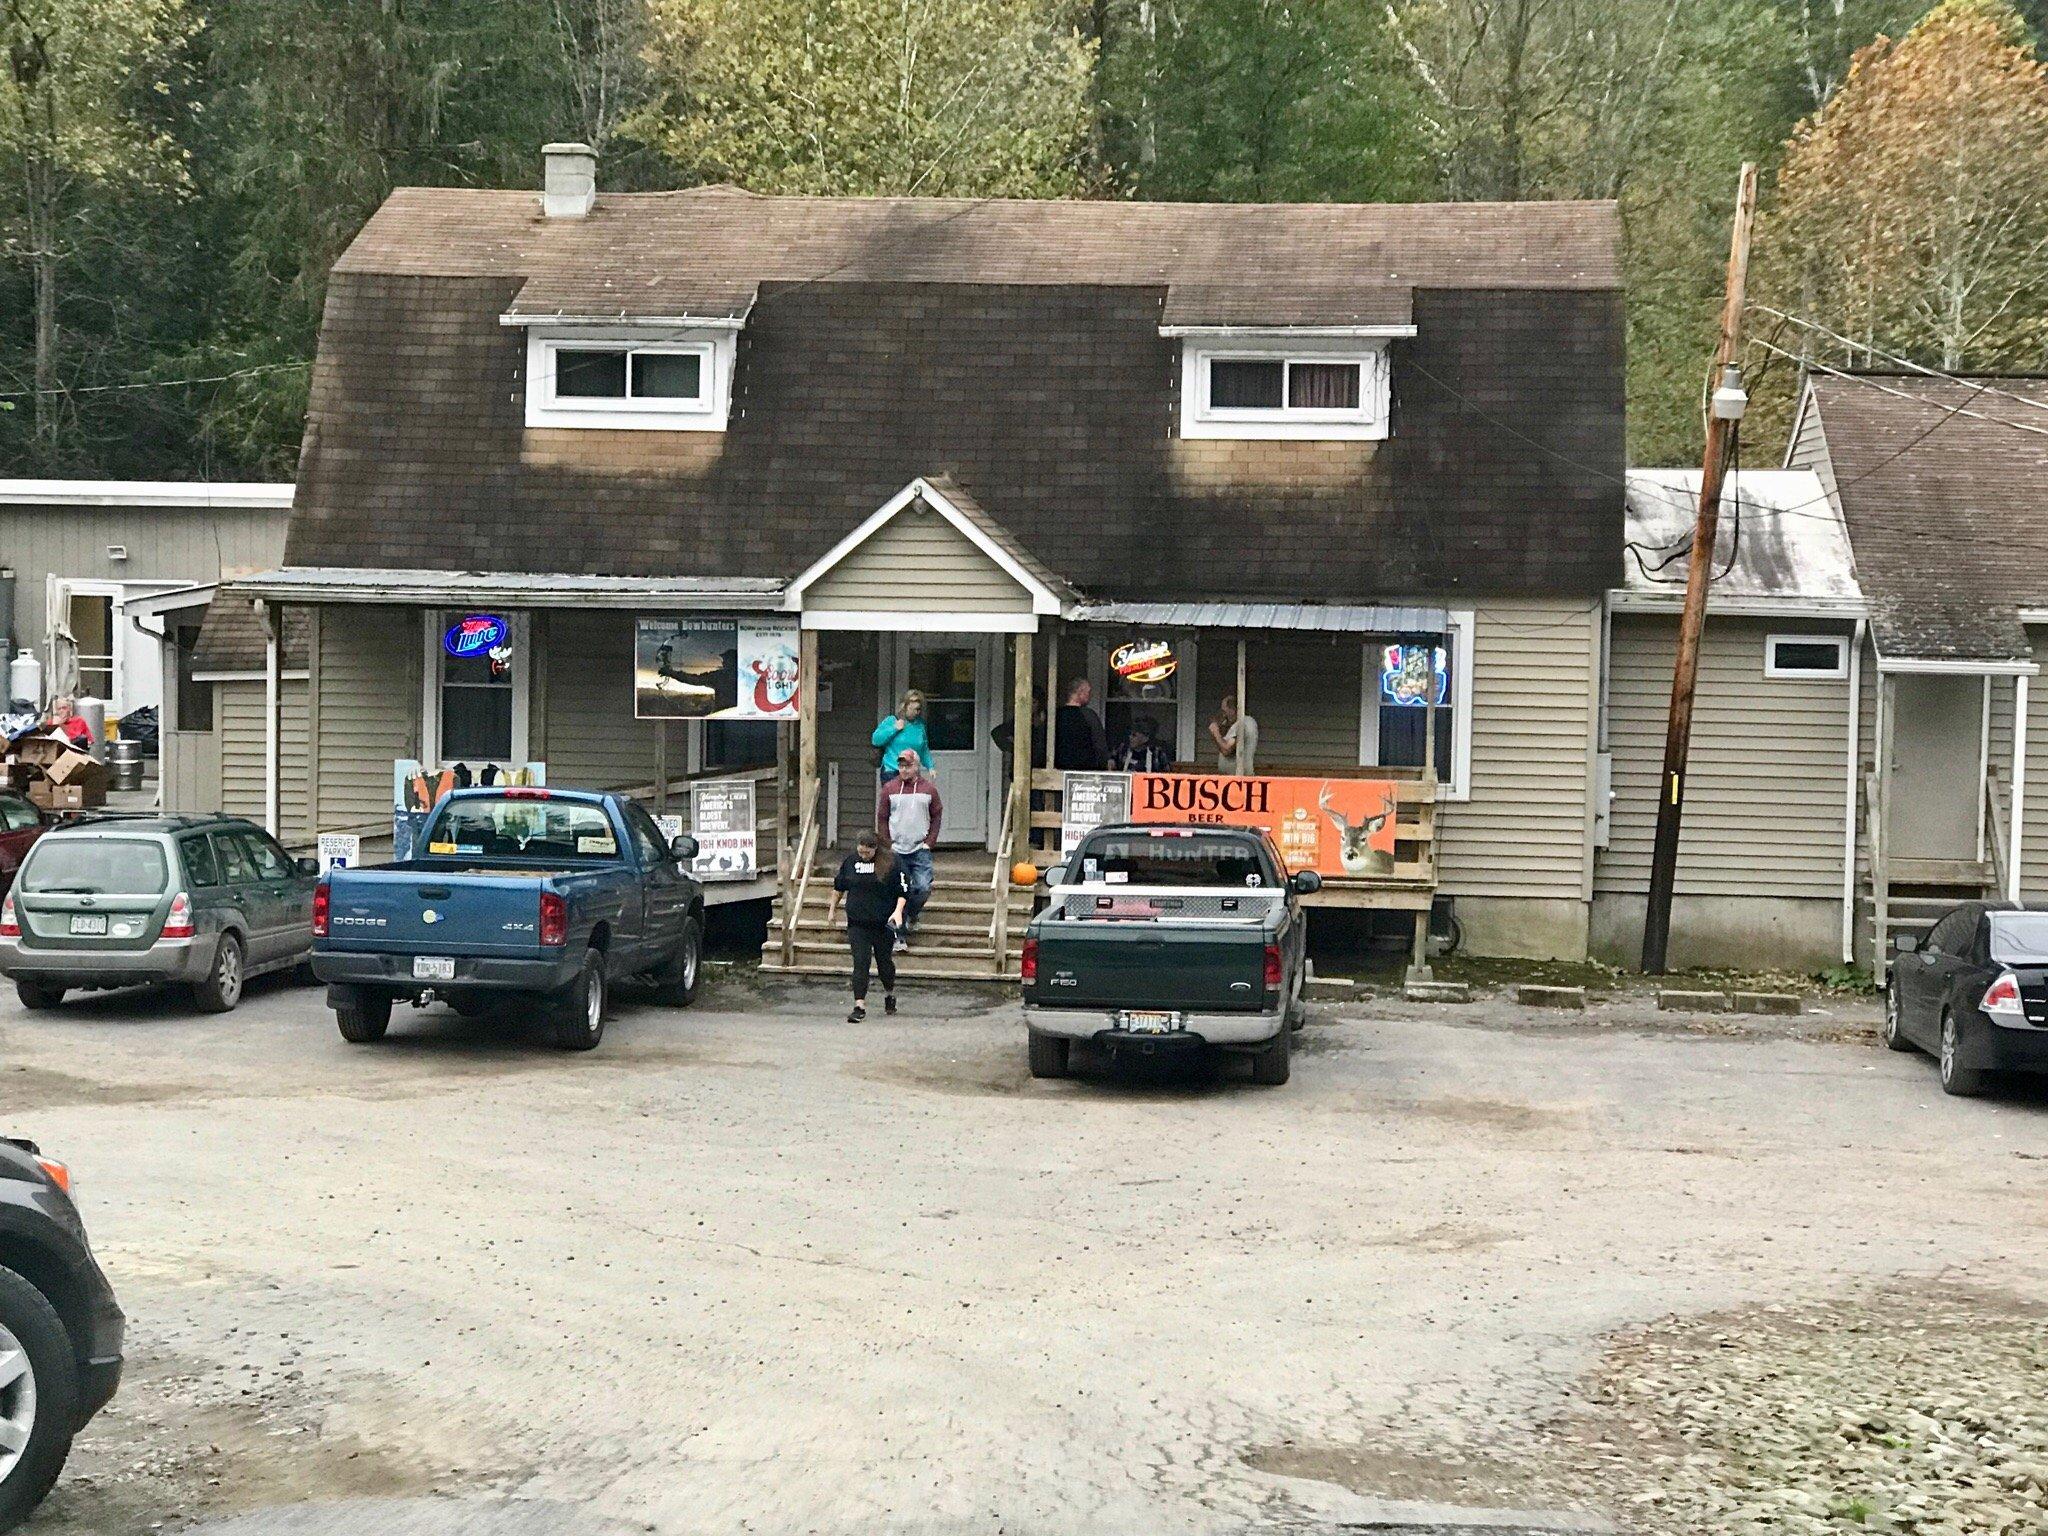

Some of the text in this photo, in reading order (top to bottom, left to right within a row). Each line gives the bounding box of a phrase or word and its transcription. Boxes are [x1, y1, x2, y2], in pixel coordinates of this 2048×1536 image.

[640, 620, 735, 631] Welcome Bowhunters
[1071, 792, 1107, 803] AMERICA'S
[1143, 777, 1271, 813] BUSCH
[700, 800, 734, 810] AMERICA'S
[1071, 802, 1095, 812] OLDEST
[700, 811, 723, 820] OLDEST
[1188, 813, 1224, 823] BEER
[1064, 830, 1085, 841] HIGH
[321, 837, 356, 847] RESERVED
[700, 838, 754, 850] IGH KNOB INN
[323, 847, 352, 857] PARKING
[333, 916, 387, 927] DODGE
